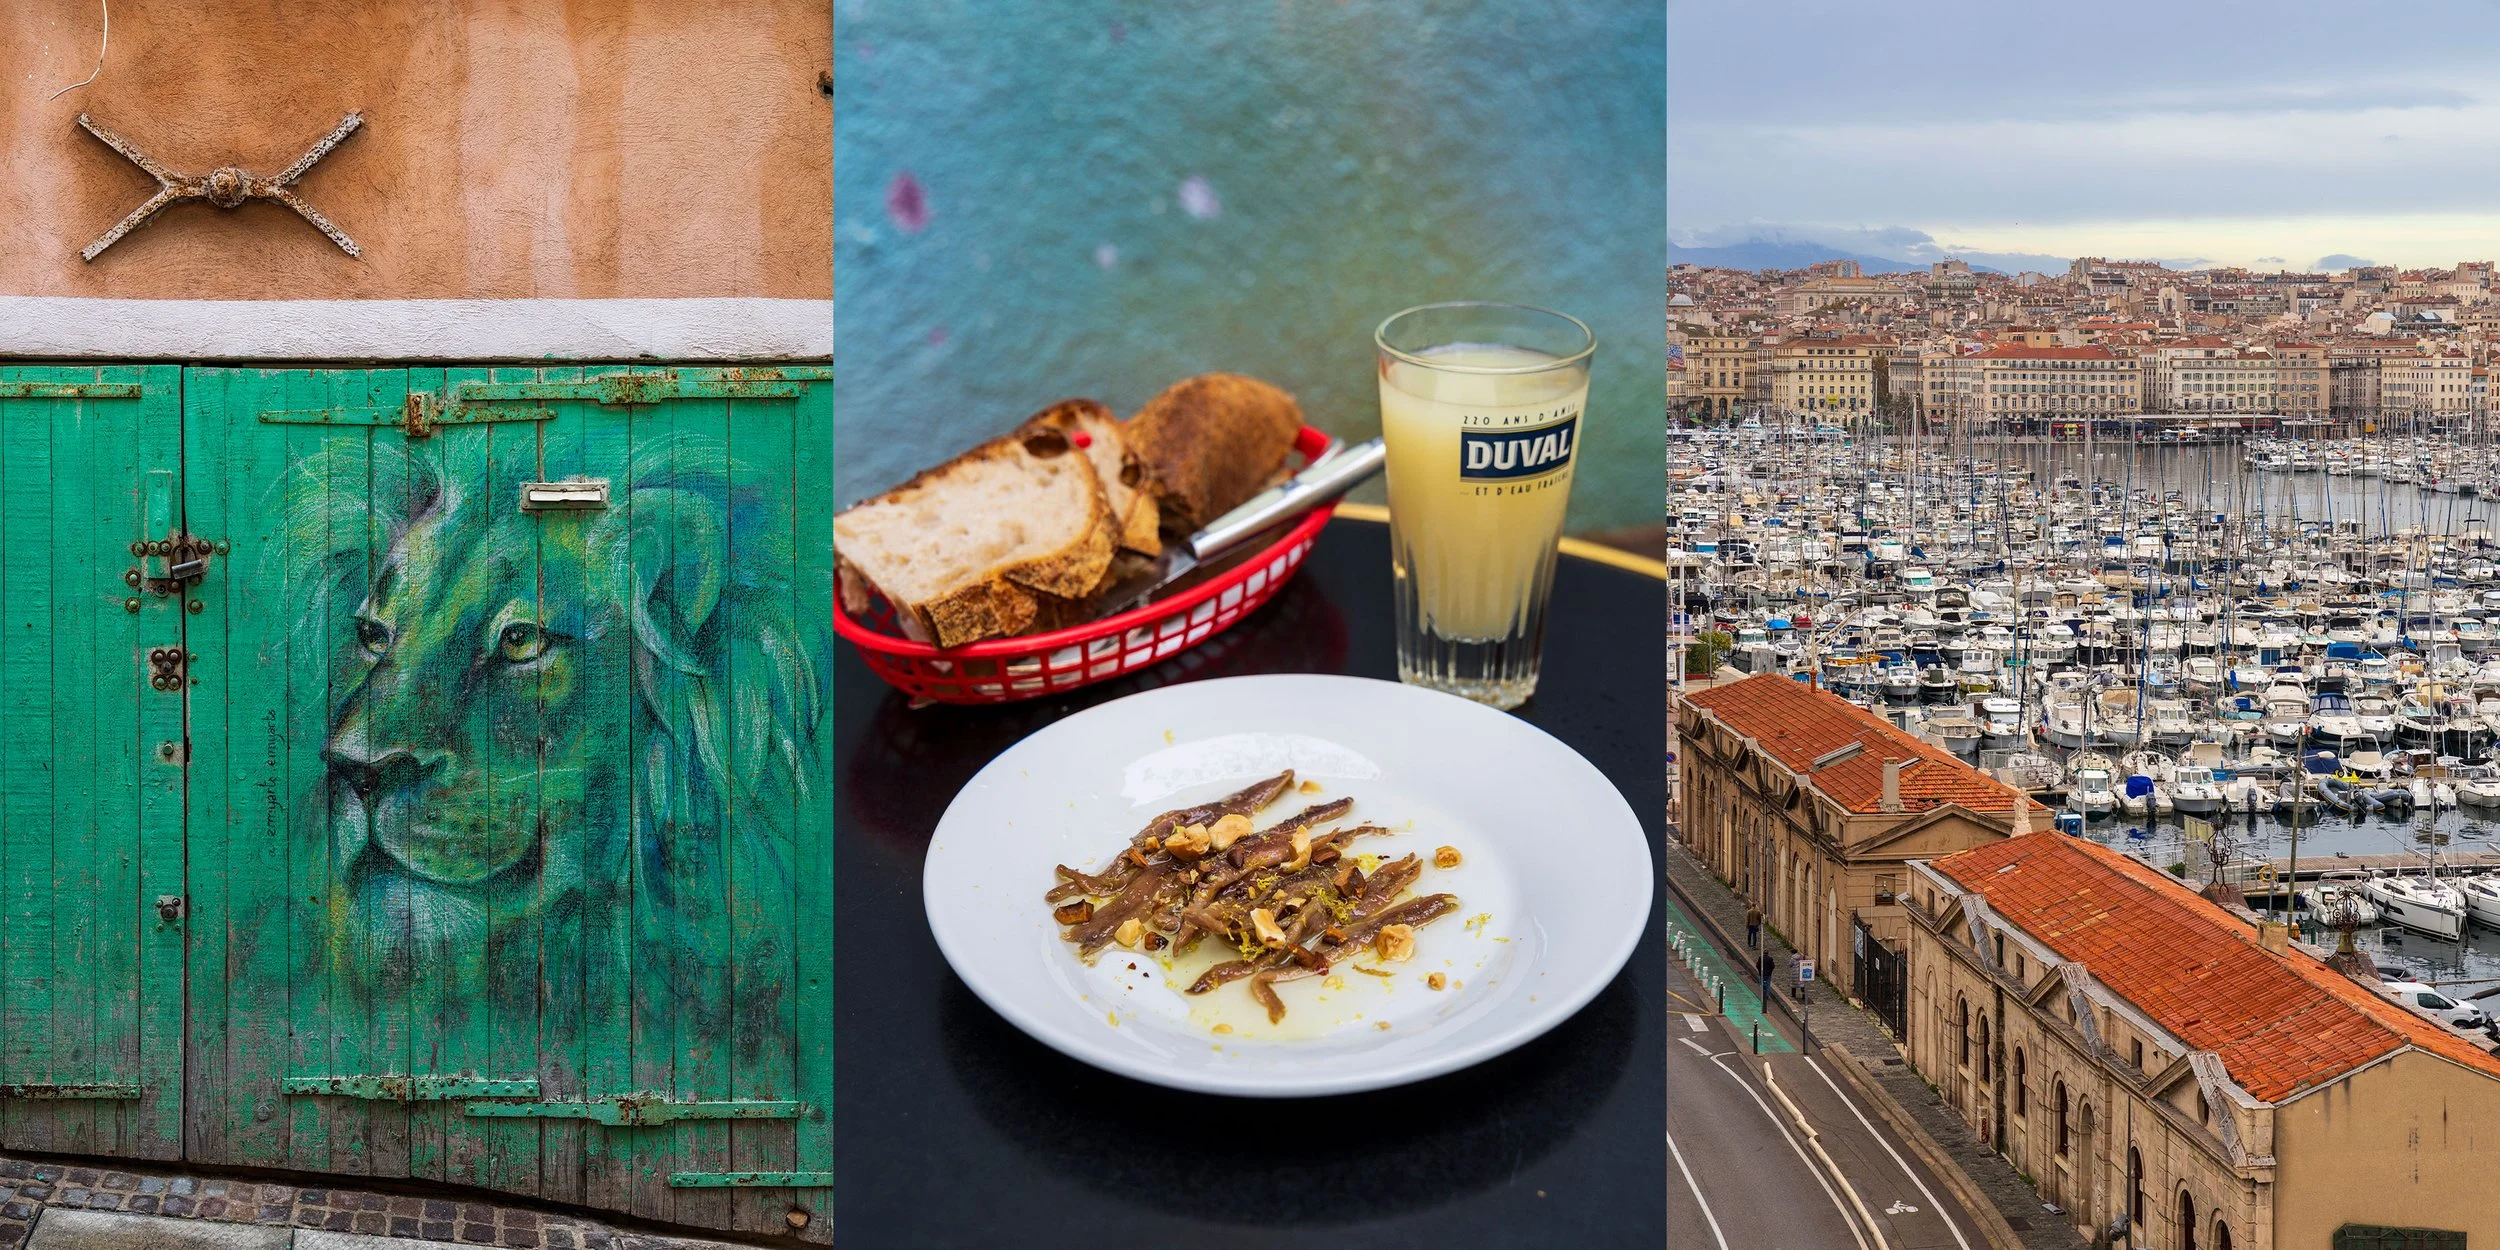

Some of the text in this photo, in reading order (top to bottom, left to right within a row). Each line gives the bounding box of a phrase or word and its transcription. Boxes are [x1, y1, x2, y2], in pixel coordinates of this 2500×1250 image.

[1463, 415, 1490, 425] 220
[1503, 415, 1529, 425] ANS
[1466, 428, 1571, 470] DUVAL
[1475, 486, 1489, 496] ET
[1496, 484, 1532, 496] D'EAU
